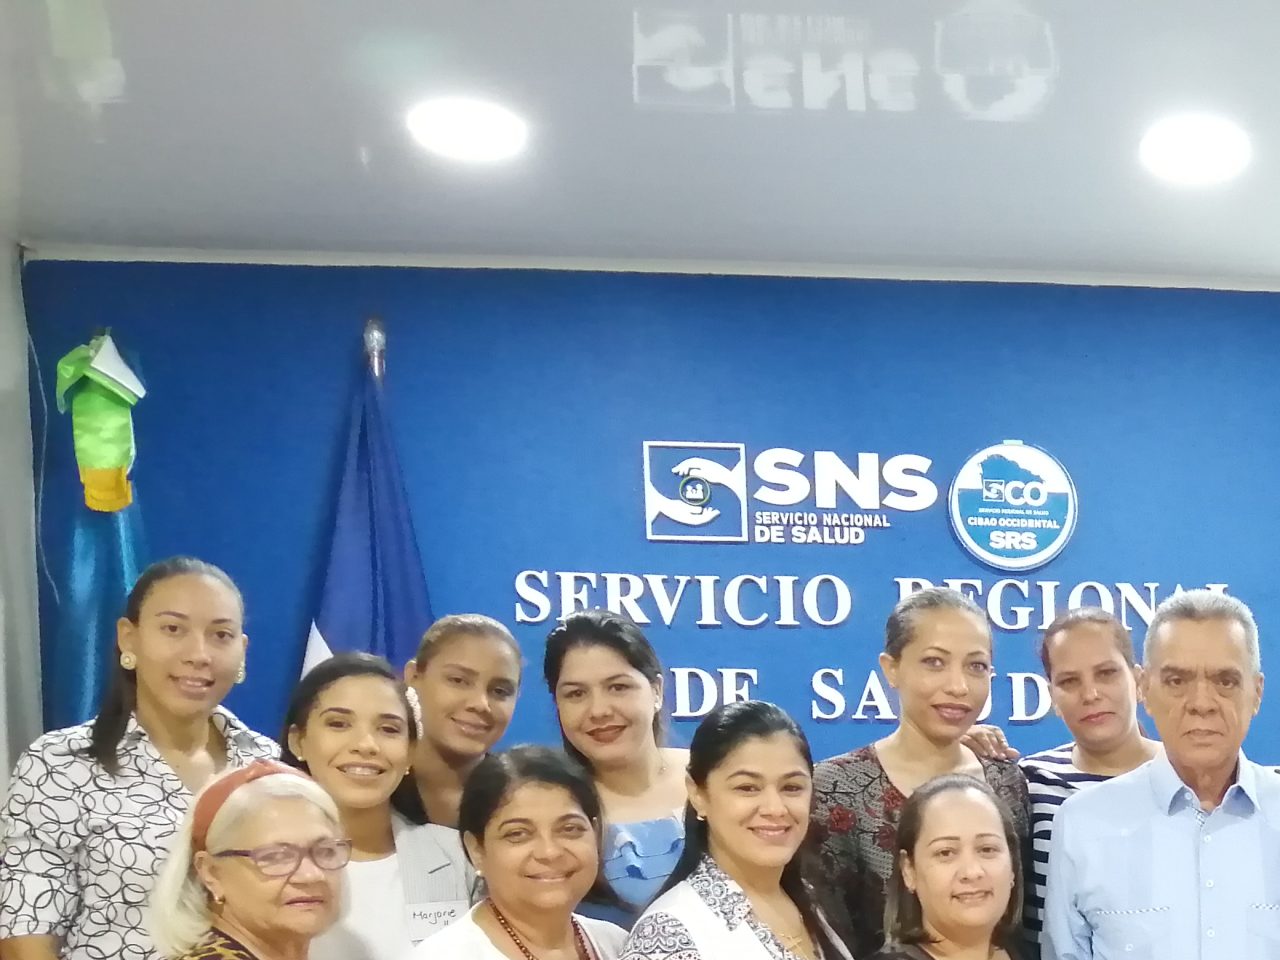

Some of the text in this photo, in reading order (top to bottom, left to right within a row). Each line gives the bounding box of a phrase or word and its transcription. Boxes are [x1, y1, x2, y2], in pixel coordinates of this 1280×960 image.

[753, 448, 938, 511] SNS
[755, 511, 891, 528] SERVICIO NACIONAL
[967, 516, 1060, 529] CIBAO OCCIDENTAL
[754, 525, 865, 544] DE SALUD
[989, 531, 1038, 550] SRS
[514, 569, 852, 627] SERVICIO
[669, 667, 758, 718] DE
[412, 908, 457, 925] Marjorie
